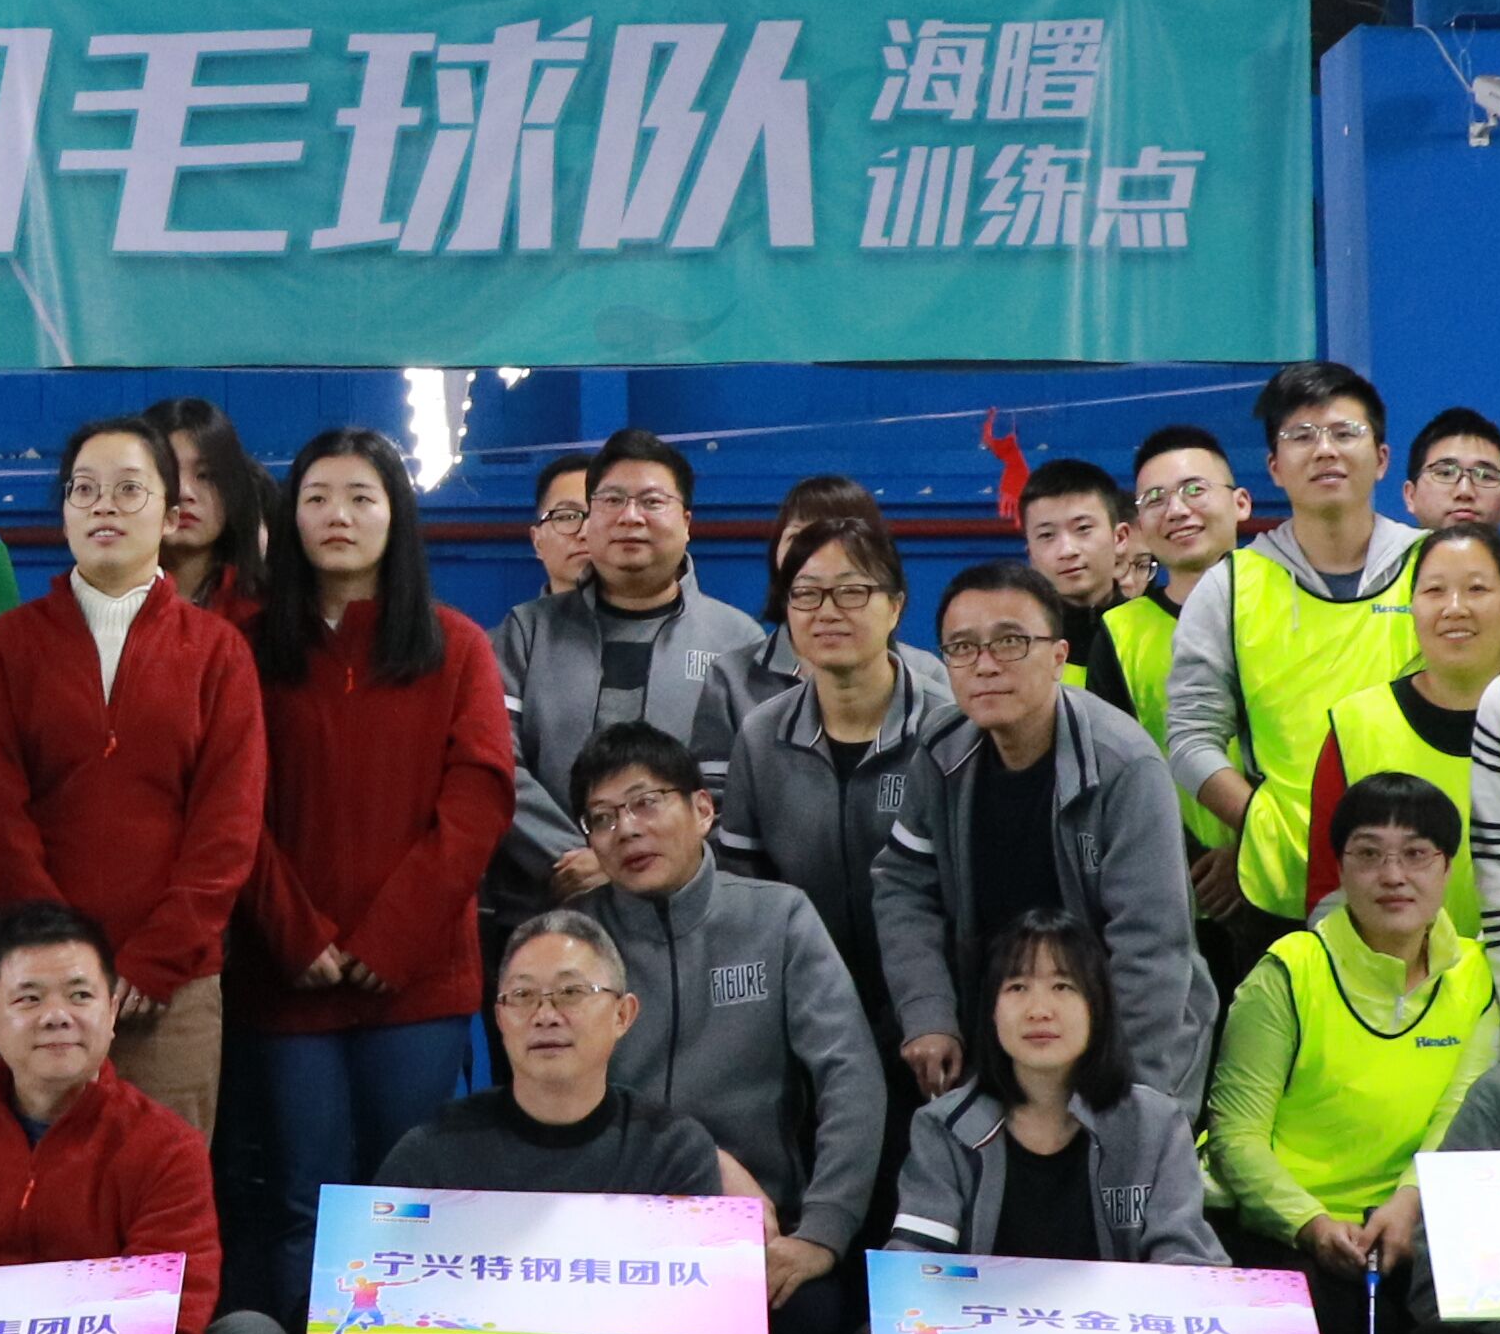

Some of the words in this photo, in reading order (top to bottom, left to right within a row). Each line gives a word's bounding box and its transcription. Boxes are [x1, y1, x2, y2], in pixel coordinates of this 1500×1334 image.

[869, 19, 1104, 120] 海曙
[860, 144, 1206, 248] 训练点
[373, 1251, 710, 1287] 宁兴特钢集团队
